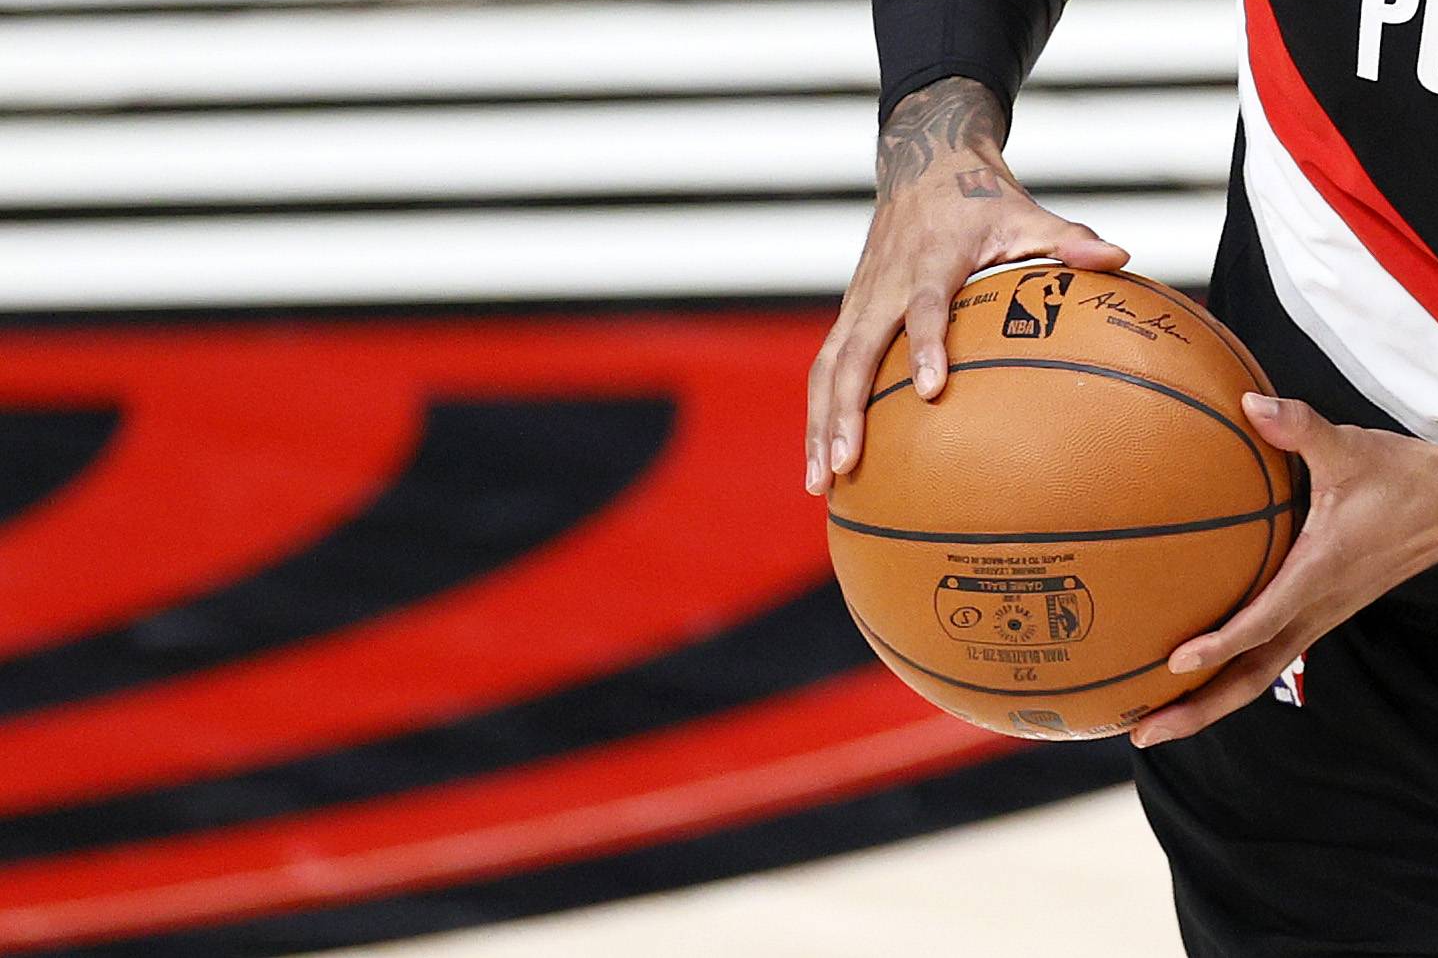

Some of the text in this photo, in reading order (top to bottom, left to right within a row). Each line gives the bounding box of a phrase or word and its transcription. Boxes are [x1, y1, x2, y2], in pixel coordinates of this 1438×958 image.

[973, 291, 1000, 305] BALL
[1007, 319, 1035, 335] NBA
[978, 581, 1043, 591] GAME BALL
[1013, 667, 1037, 681] 22
